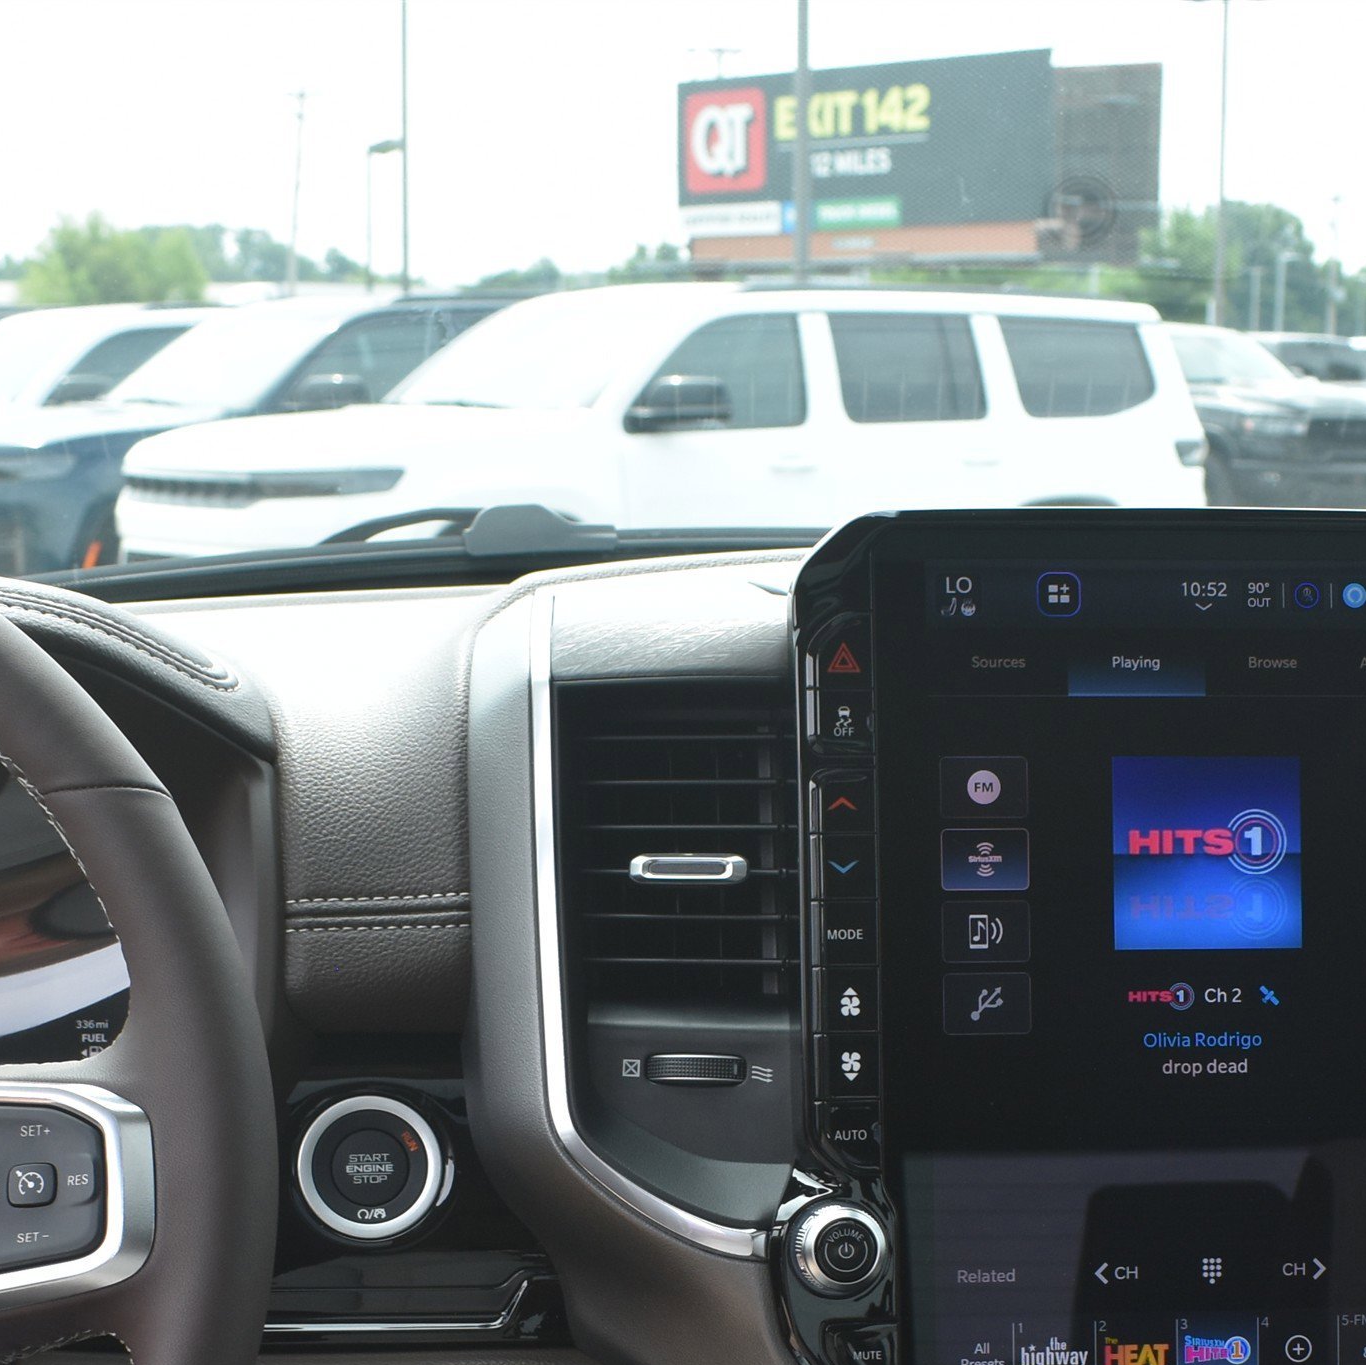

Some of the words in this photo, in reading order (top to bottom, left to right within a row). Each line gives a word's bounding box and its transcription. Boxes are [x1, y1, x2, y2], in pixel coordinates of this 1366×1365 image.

[861, 83, 932, 134] 142
[945, 576, 973, 594] LO
[1181, 582, 1227, 597] 10:52
[1248, 582, 1270, 594] 90°
[1248, 598, 1271, 608] OUT
[972, 656, 1026, 669] Sources
[1112, 656, 1160, 671] Playing
[1248, 656, 1297, 669] Browse
[833, 727, 855, 738] OFF
[974, 782, 994, 794] FM
[1128, 828, 1235, 856] HITS
[827, 929, 864, 940] MODE
[1128, 990, 1174, 1003] HITS
[1204, 987, 1228, 1003] Ch
[1232, 988, 1242, 1003] 2
[82, 1034, 107, 1043] FUEL
[1143, 1032, 1191, 1048] Olivia
[1195, 1031, 1262, 1050] Rodrigo
[1162, 1059, 1203, 1077] drop
[1206, 1058, 1248, 1074] dead
[835, 1130, 868, 1141] AUTO
[349, 1153, 390, 1163] START
[346, 1164, 394, 1173] ENGINE
[67, 1174, 89, 1186] RES
[353, 1175, 388, 1184] STOP
[826, 1228, 865, 1244] VOLUME
[957, 1268, 1016, 1283] Related
[1114, 1266, 1139, 1280] CH
[1283, 1263, 1305, 1276] CH
[1098, 1321, 1107, 1332] 2
[1180, 1319, 1188, 1330] 3
[1261, 1317, 1269, 1328] 4
[974, 1343, 990, 1354] All
[1050, 1336, 1067, 1350] the
[853, 1351, 883, 1361] MUTE
